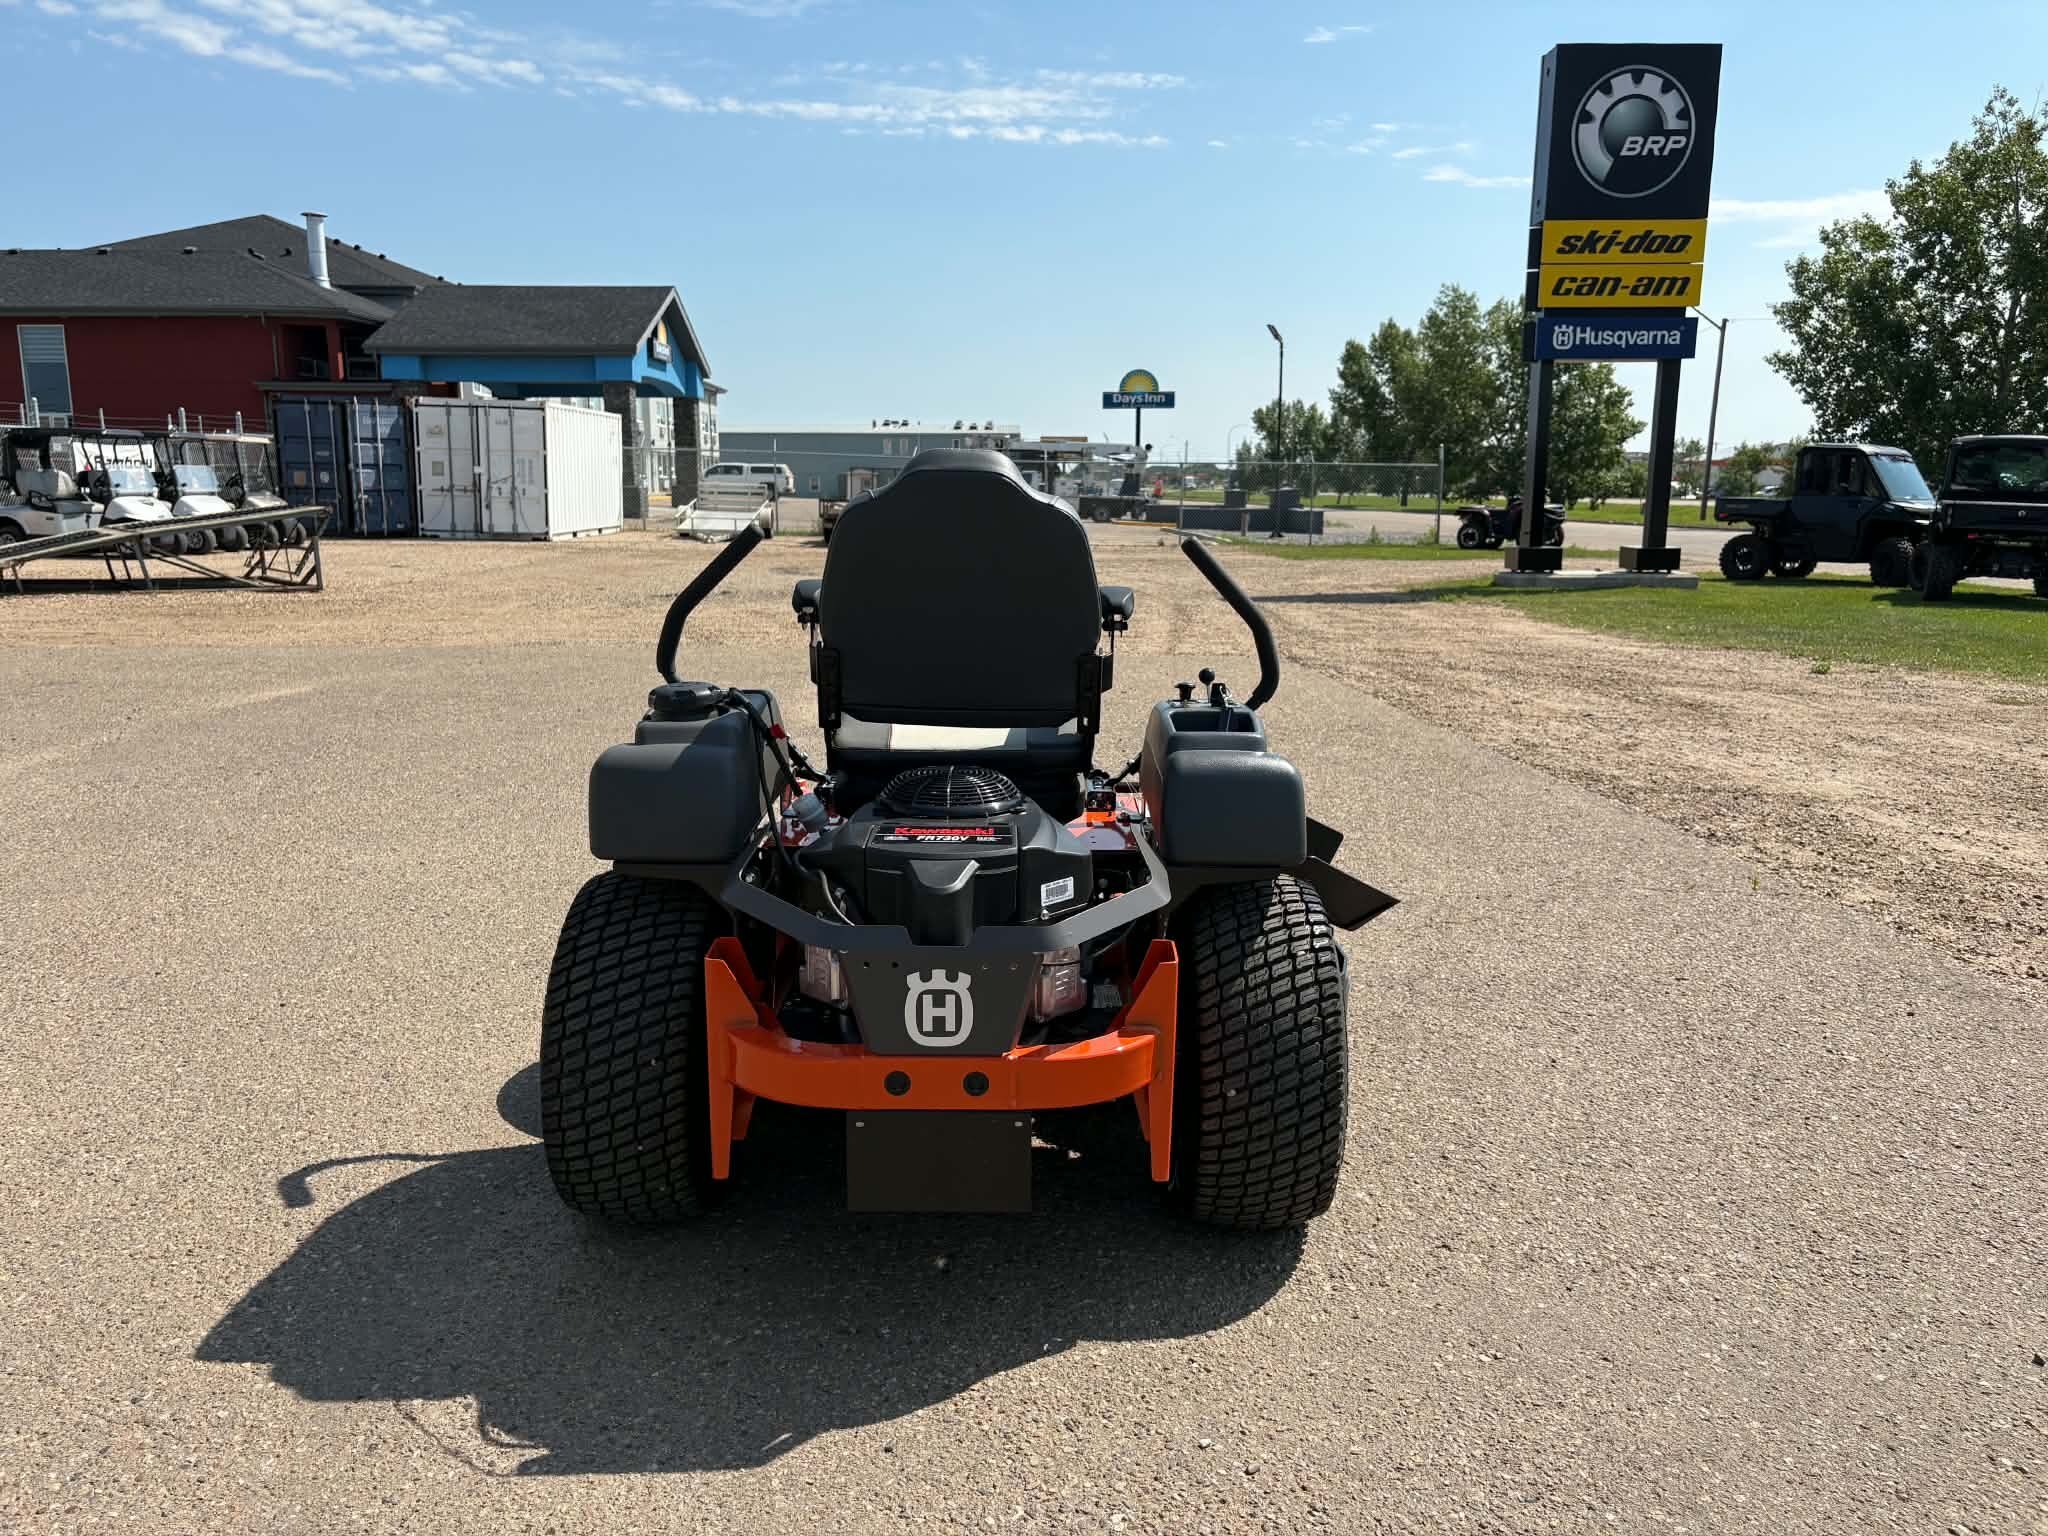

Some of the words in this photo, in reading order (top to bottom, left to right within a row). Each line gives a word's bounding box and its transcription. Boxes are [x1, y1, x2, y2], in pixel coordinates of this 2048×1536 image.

[1619, 135, 1687, 156] BRP
[1556, 229, 1693, 255] ski-doo
[1551, 276, 1691, 297] can-am
[1575, 326, 1681, 348] Husqvarna
[894, 827, 995, 836] Kawasaki
